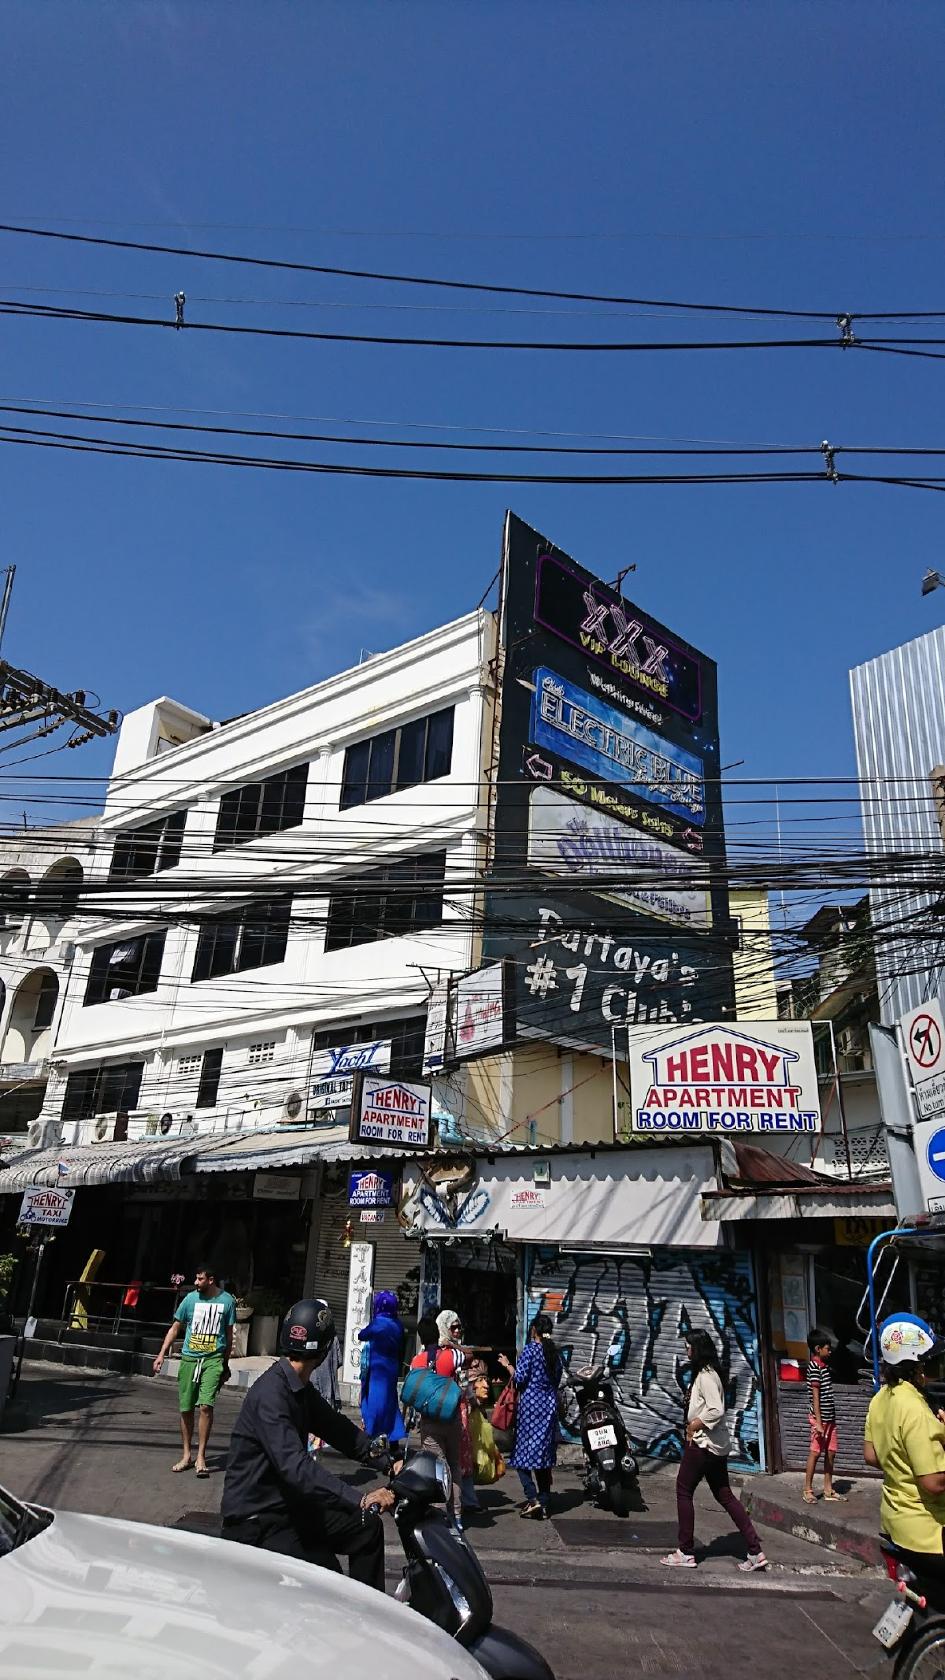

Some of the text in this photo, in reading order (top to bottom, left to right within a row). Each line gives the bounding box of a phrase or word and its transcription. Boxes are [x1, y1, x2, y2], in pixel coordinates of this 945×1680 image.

[580, 591, 670, 684] XXX
[579, 631, 669, 697] VIP LOUNGE
[541, 690, 648, 772] ELECTRIC
[651, 753, 703, 801] BLUE
[524, 953, 588, 1012] #1
[666, 1042, 781, 1083] HENRY
[375, 1088, 417, 1111] HENRY
[645, 1088, 800, 1108] APARTMENT
[923, 1102, 932, 1113] No
[362, 1110, 425, 1130] APARTMENT
[638, 1111, 817, 1131] ROOM FOR RENT
[360, 1124, 427, 1143] ROOM FOR RENT
[359, 1175, 384, 1190] HENRY
[33, 1193, 63, 1208] HENRY
[349, 1197, 391, 1205] ROOM FOR RENT
[351, 1189, 390, 1198] APARTMENT
[515, 1190, 540, 1201] HENRY
[42, 1209, 62, 1218] TAXI
